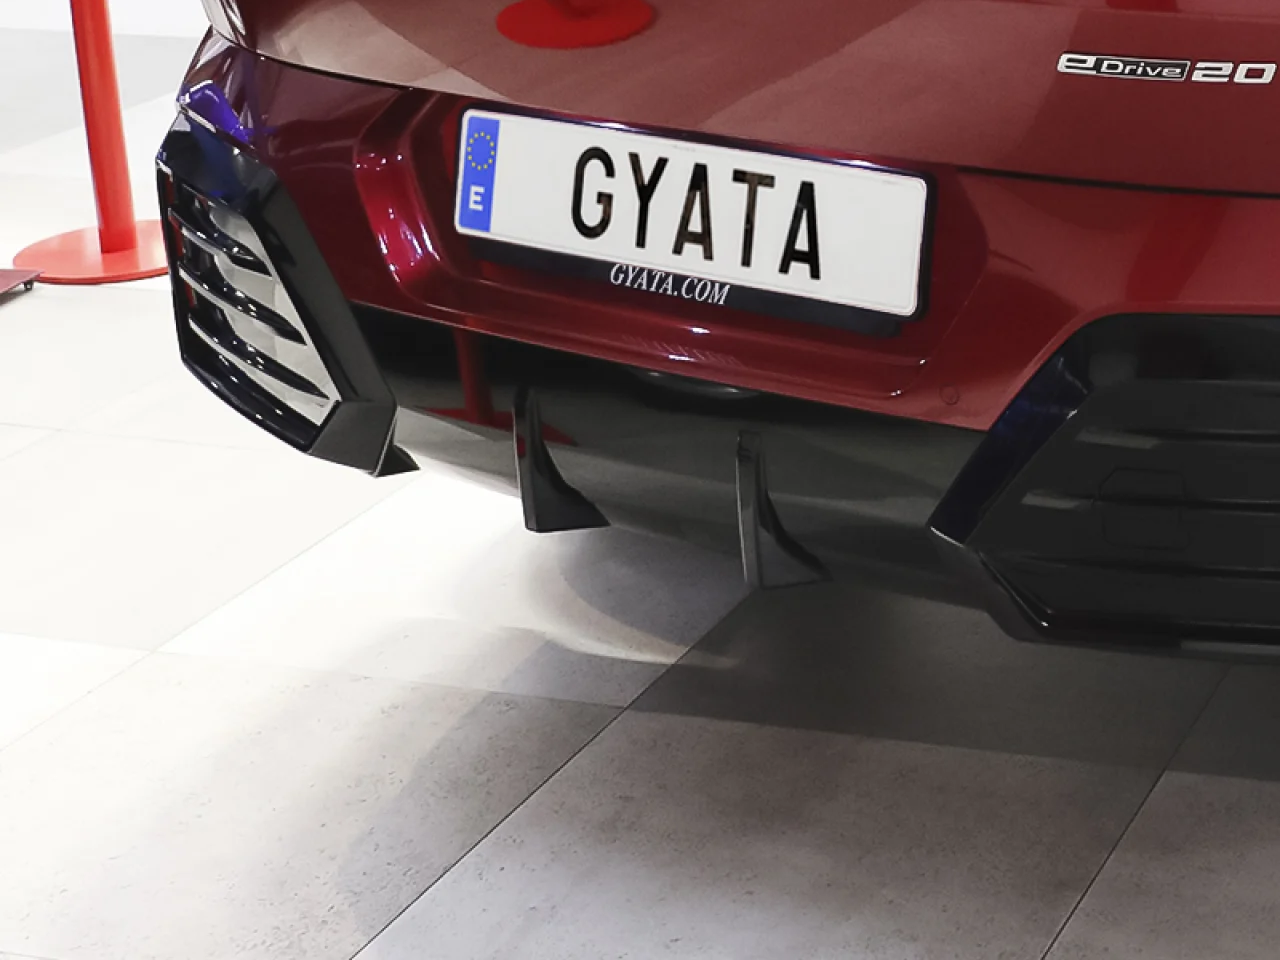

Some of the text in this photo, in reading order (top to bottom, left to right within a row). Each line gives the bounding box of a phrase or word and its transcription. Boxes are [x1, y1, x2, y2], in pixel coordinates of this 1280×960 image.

[1191, 61, 1277, 84] 20
[469, 186, 484, 211] E
[572, 146, 821, 280] GYATA
[610, 263, 730, 305] GYATA.COM
